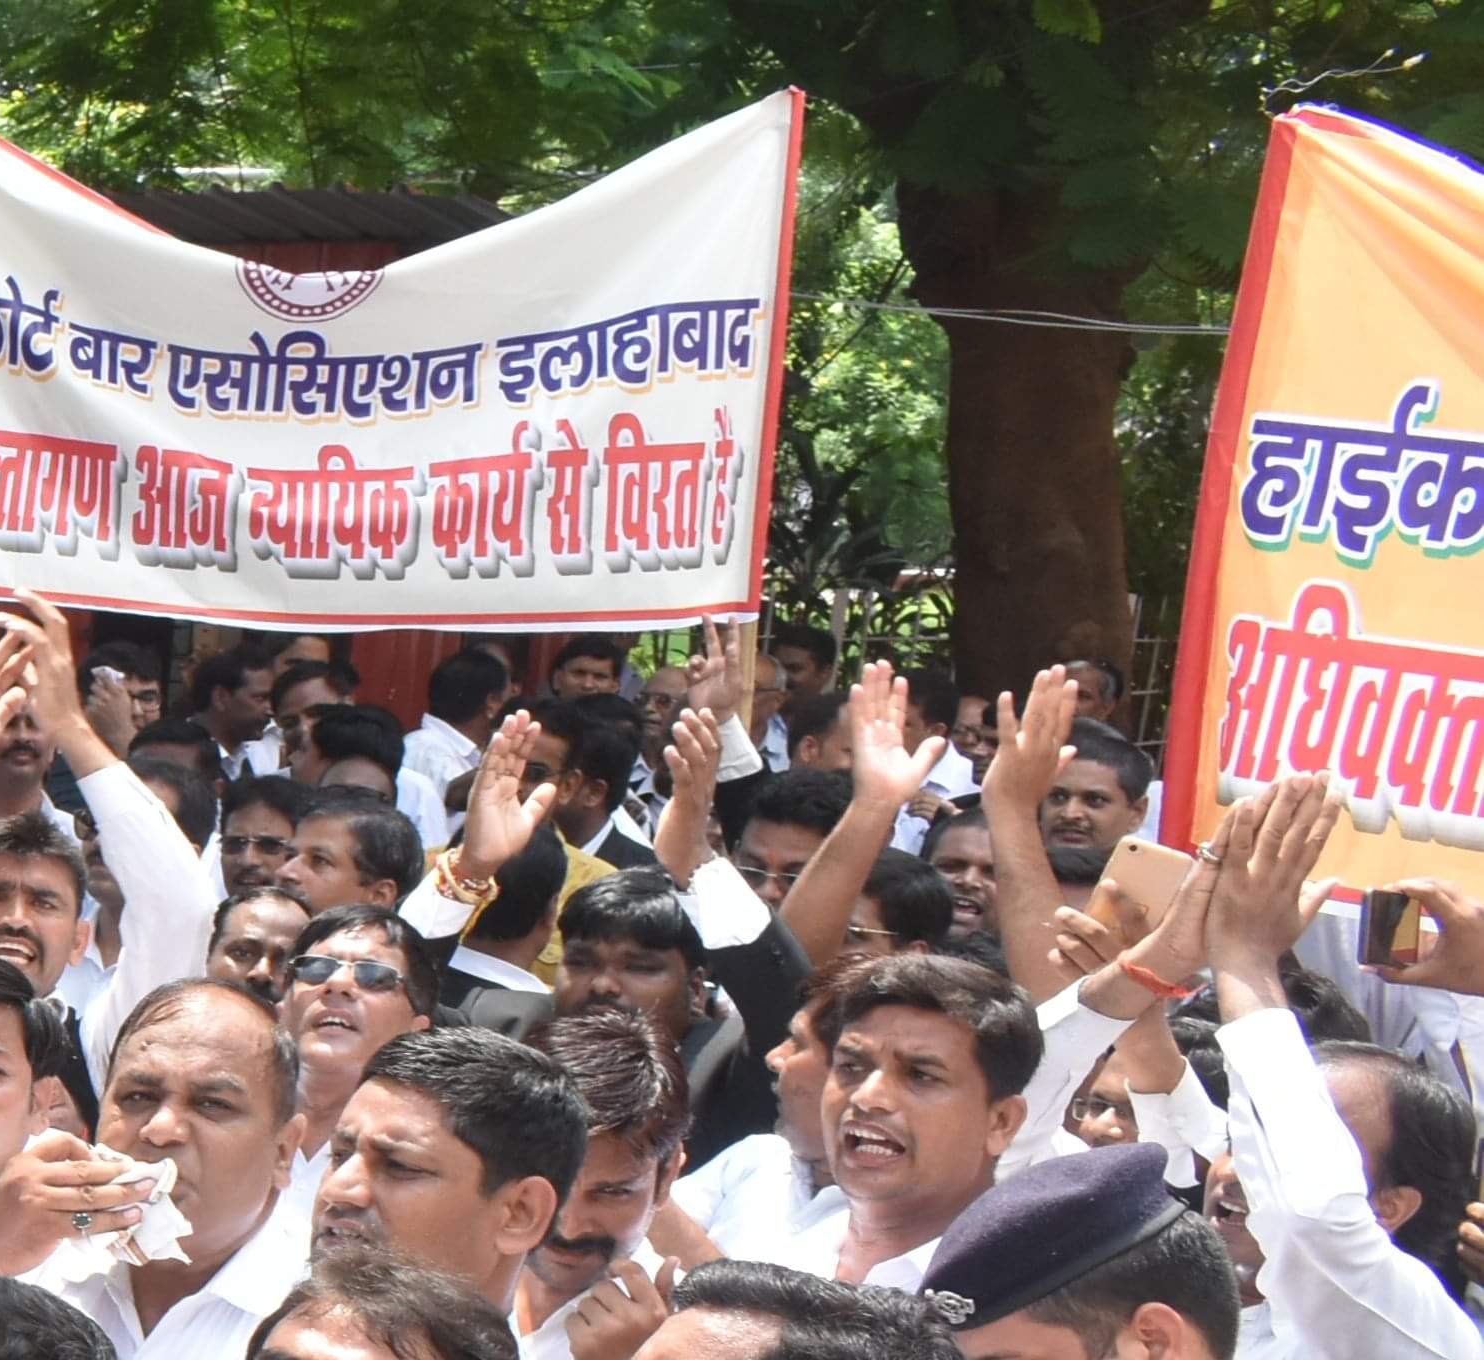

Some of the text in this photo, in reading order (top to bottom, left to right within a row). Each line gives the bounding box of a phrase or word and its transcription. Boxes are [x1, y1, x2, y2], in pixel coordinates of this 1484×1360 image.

[68, 322, 159, 394] बार
[167, 330, 484, 418] एसोसिएशन
[495, 298, 761, 402] इलाहाबाद
[131, 444, 235, 557] आज
[246, 443, 416, 564] न्यायिक
[428, 419, 535, 562] कार्य
[546, 418, 590, 560] से
[602, 411, 708, 557] विरत
